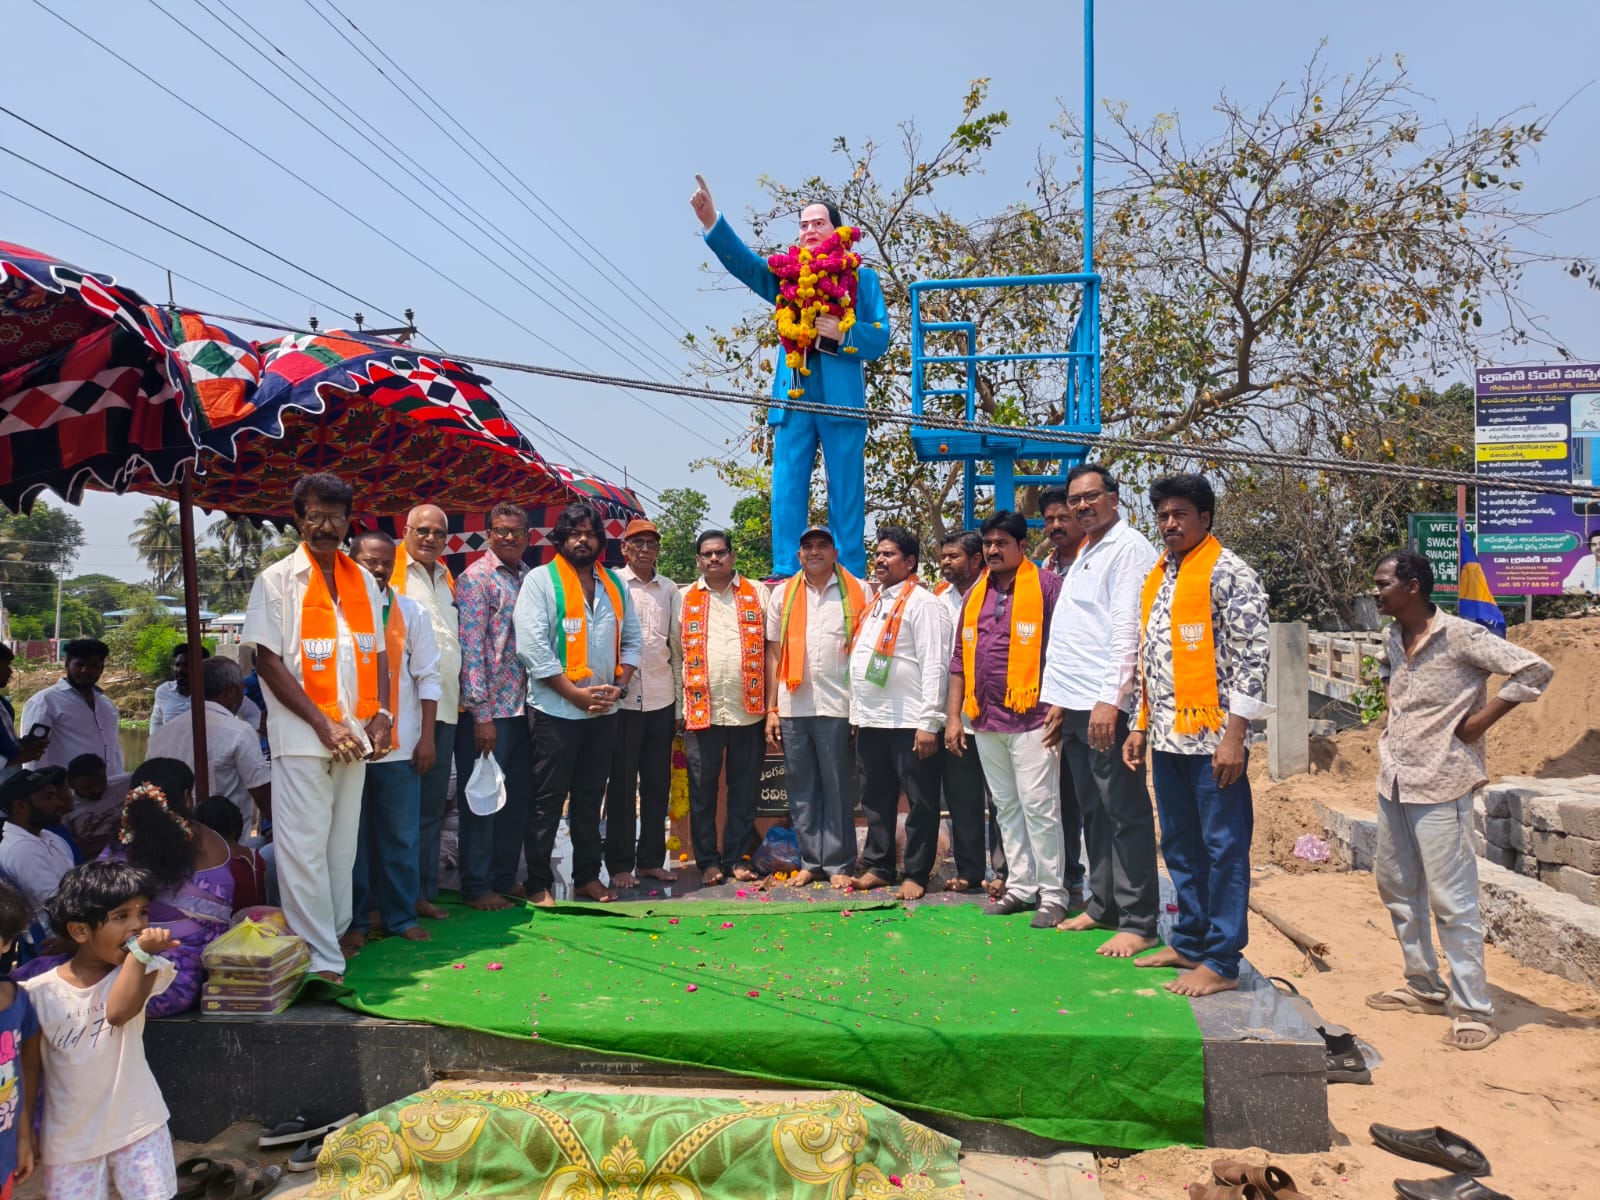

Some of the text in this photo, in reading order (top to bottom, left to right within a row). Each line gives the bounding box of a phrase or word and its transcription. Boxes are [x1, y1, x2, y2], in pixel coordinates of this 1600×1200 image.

[1527, 369, 1562, 381] కంటి
[1430, 523, 1477, 533] WELO
[745, 611, 757, 622] B
[689, 621, 700, 633] B
[750, 677, 758, 689] P
[694, 691, 703, 703] P
